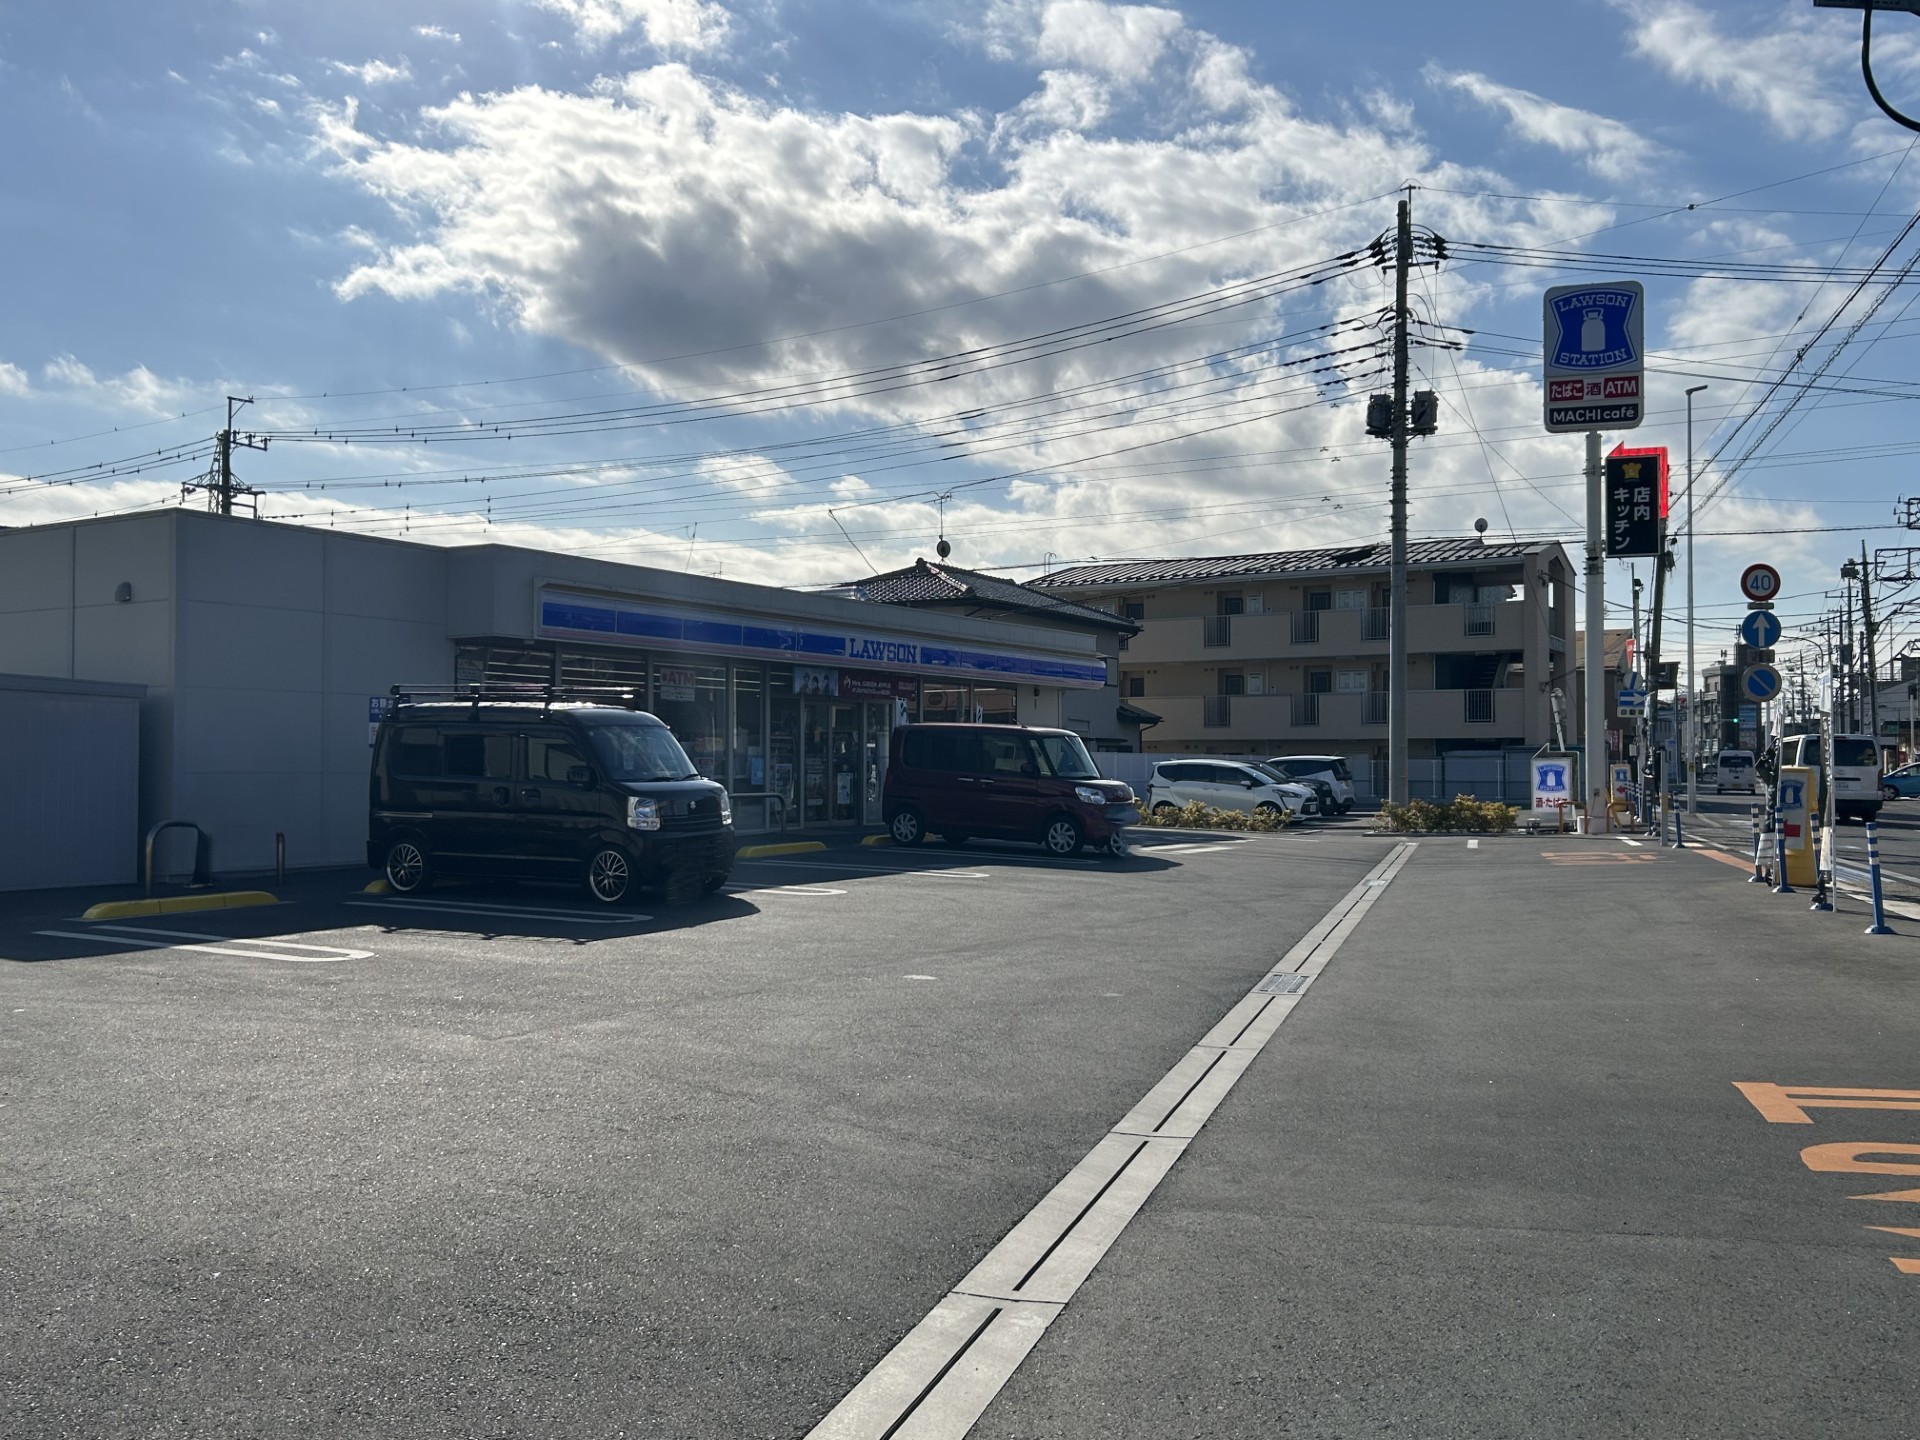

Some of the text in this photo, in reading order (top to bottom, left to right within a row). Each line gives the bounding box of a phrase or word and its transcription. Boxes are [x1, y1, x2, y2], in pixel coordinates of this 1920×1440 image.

[1558, 294, 1629, 312] LAWSON
[1559, 347, 1628, 366] STATION
[1551, 382, 1583, 399] たばこ
[1585, 382, 1602, 396] 酒
[1605, 380, 1637, 395] ATM
[1553, 406, 1635, 423] MACHI café
[1633, 486, 1651, 521] 店内
[1613, 487, 1630, 550] キッチン
[1750, 574, 1772, 591] 40
[849, 638, 918, 664] LAWSON
[667, 671, 695, 686] ATM
